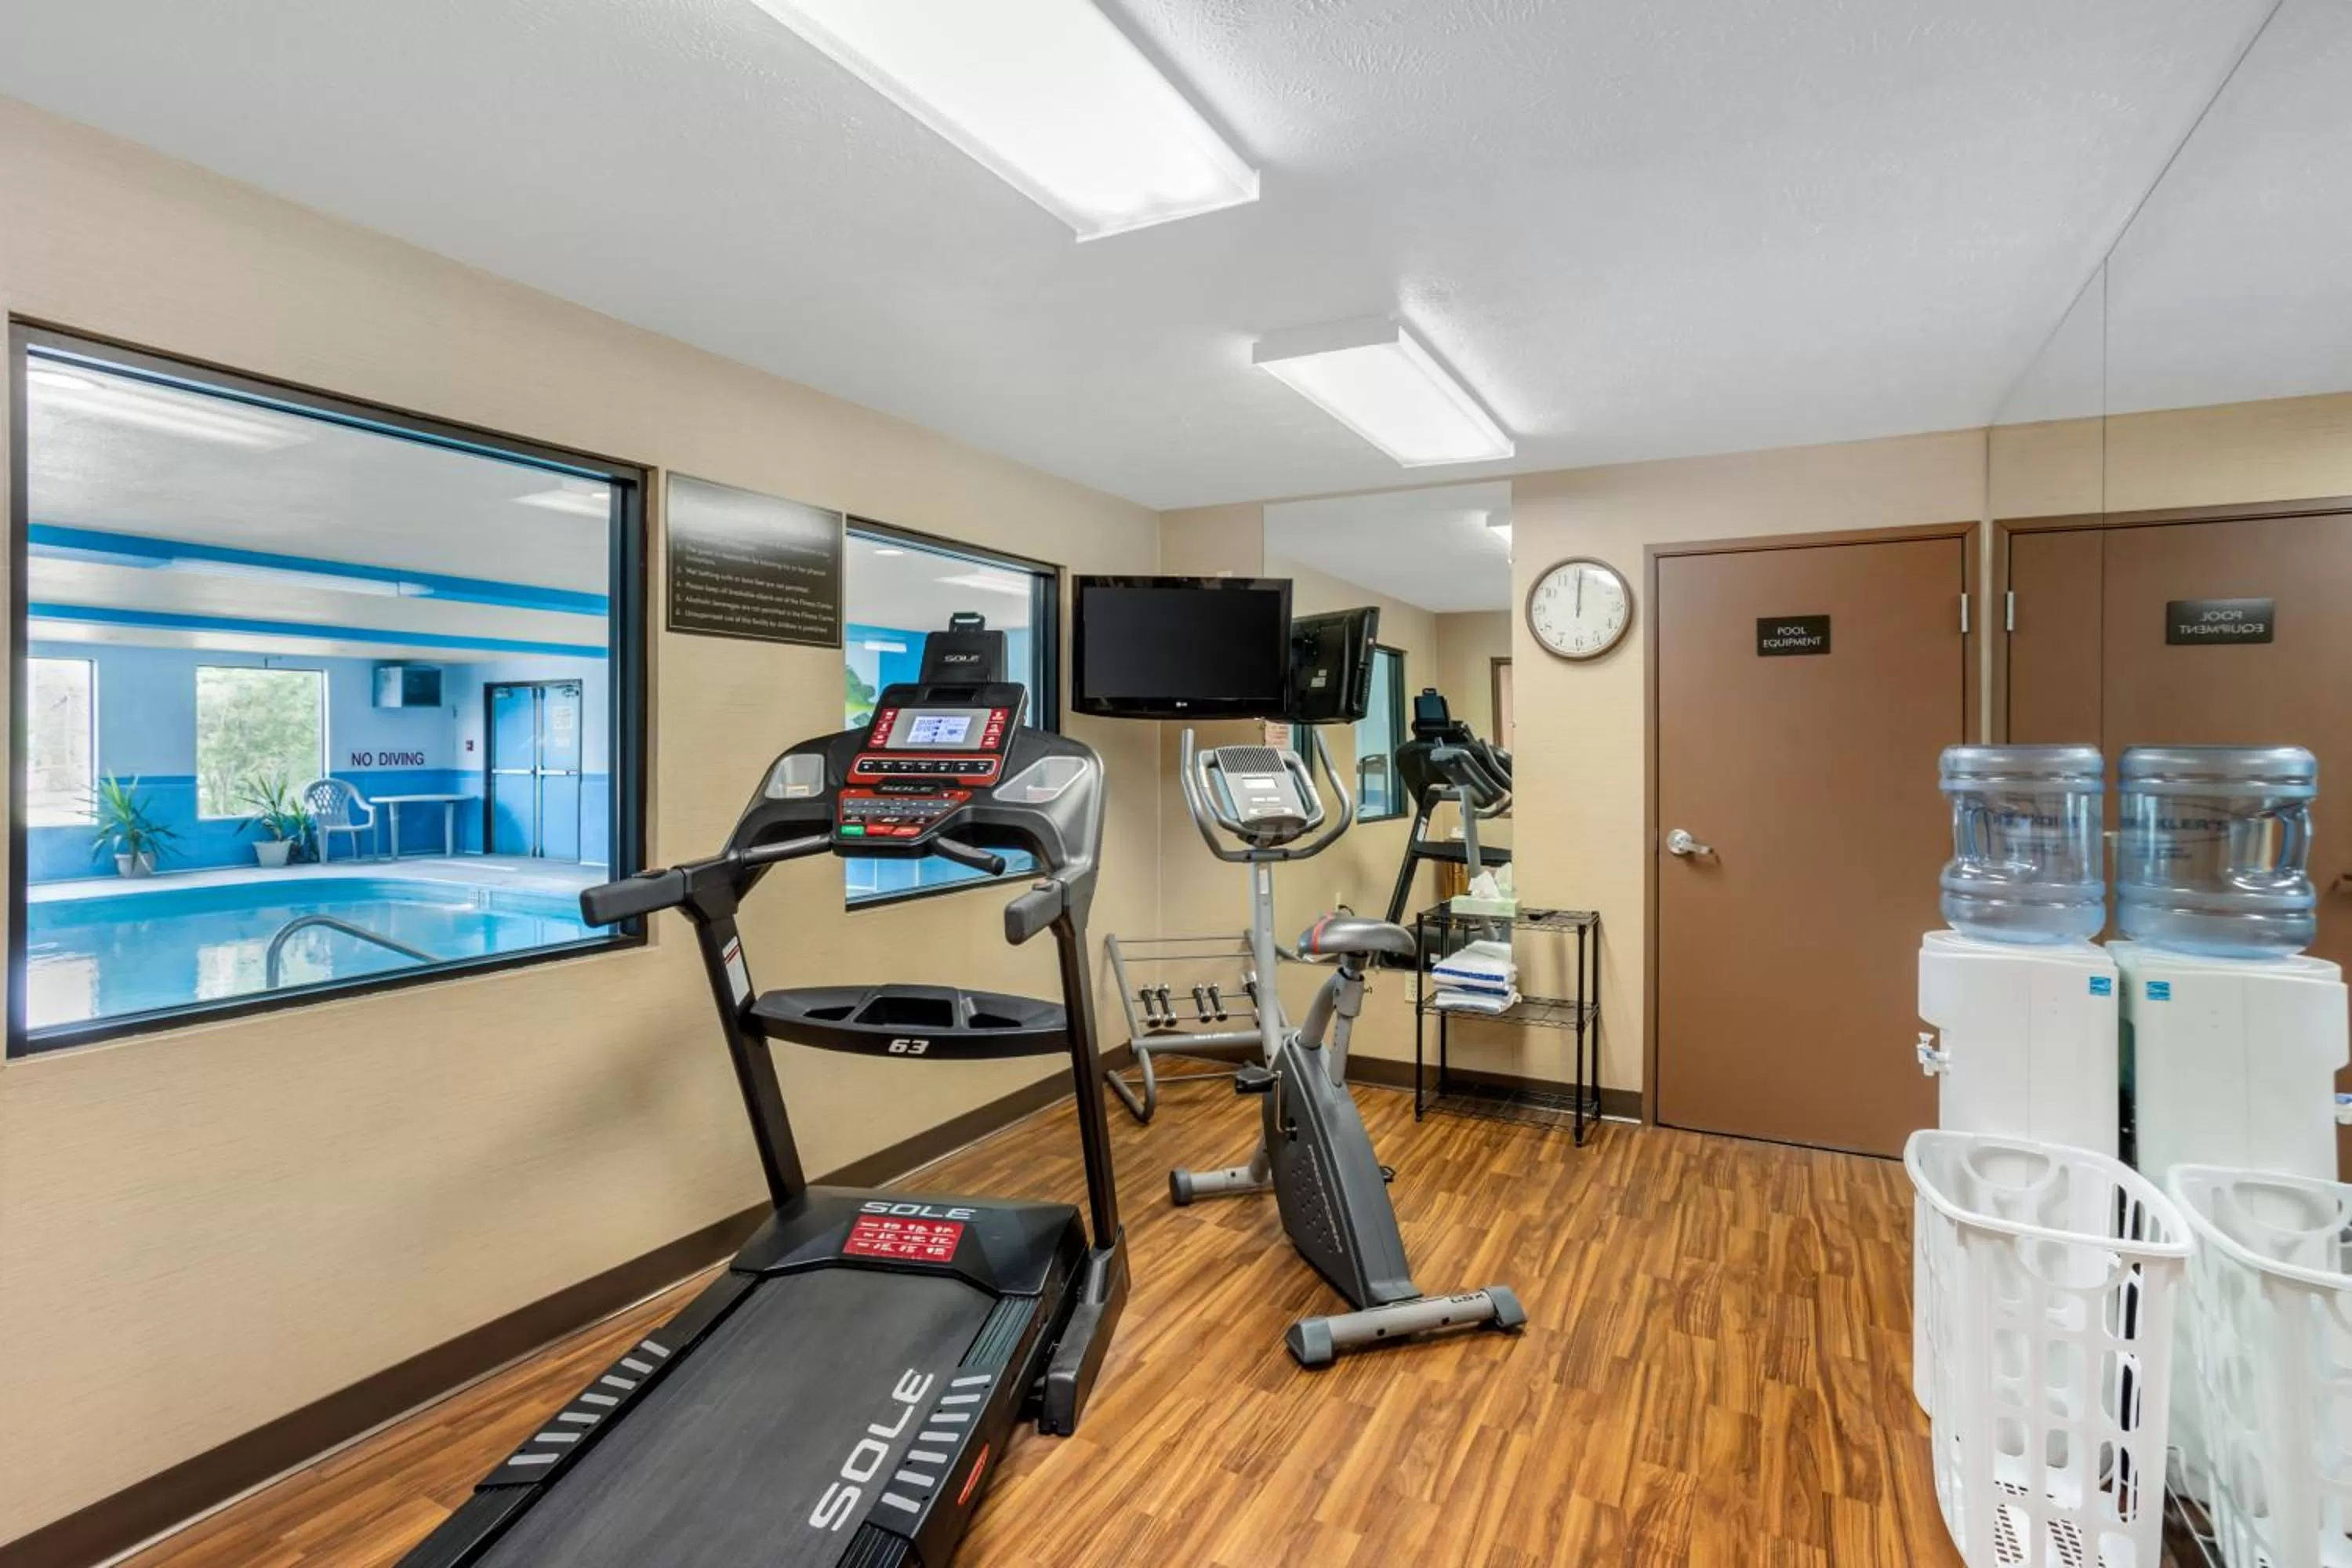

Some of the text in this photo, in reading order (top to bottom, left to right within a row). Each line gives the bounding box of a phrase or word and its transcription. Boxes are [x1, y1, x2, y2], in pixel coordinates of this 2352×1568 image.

[1777, 626, 1806, 636] POOL
[1762, 637, 1822, 648] EQUIPMENT
[943, 654, 980, 662] SOLE
[351, 752, 424, 766] NO DIVING
[888, 1039, 929, 1054] 63
[860, 1201, 978, 1220] SOLE
[808, 1367, 934, 1531] SOLE
